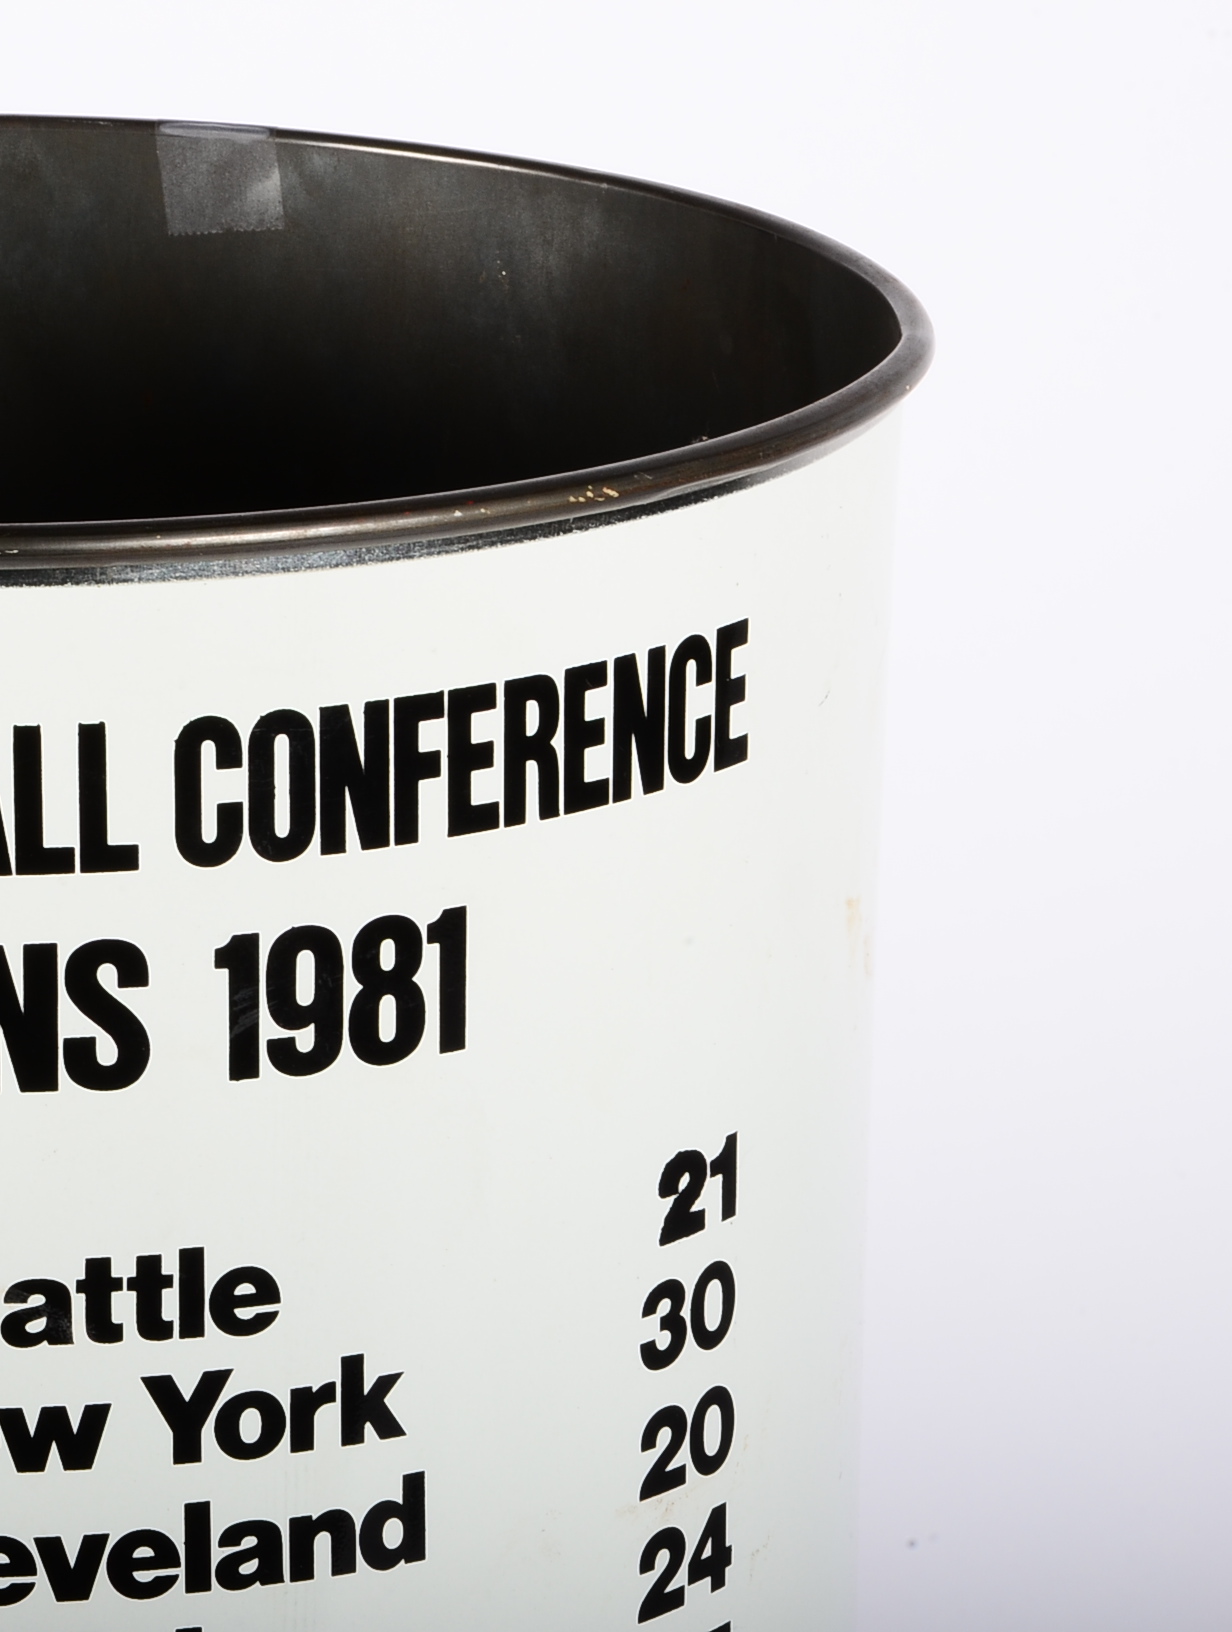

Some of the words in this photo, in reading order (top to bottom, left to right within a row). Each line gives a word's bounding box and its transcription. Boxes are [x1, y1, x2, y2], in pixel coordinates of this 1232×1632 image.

[175, 619, 749, 868] CONFERENCE
[215, 906, 467, 1082] 1981
[658, 1132, 738, 1247] 21
[140, 1353, 407, 1466] York
[639, 1260, 736, 1371] 30
[639, 1385, 735, 1502] 20
[637, 1502, 733, 1625] 24
